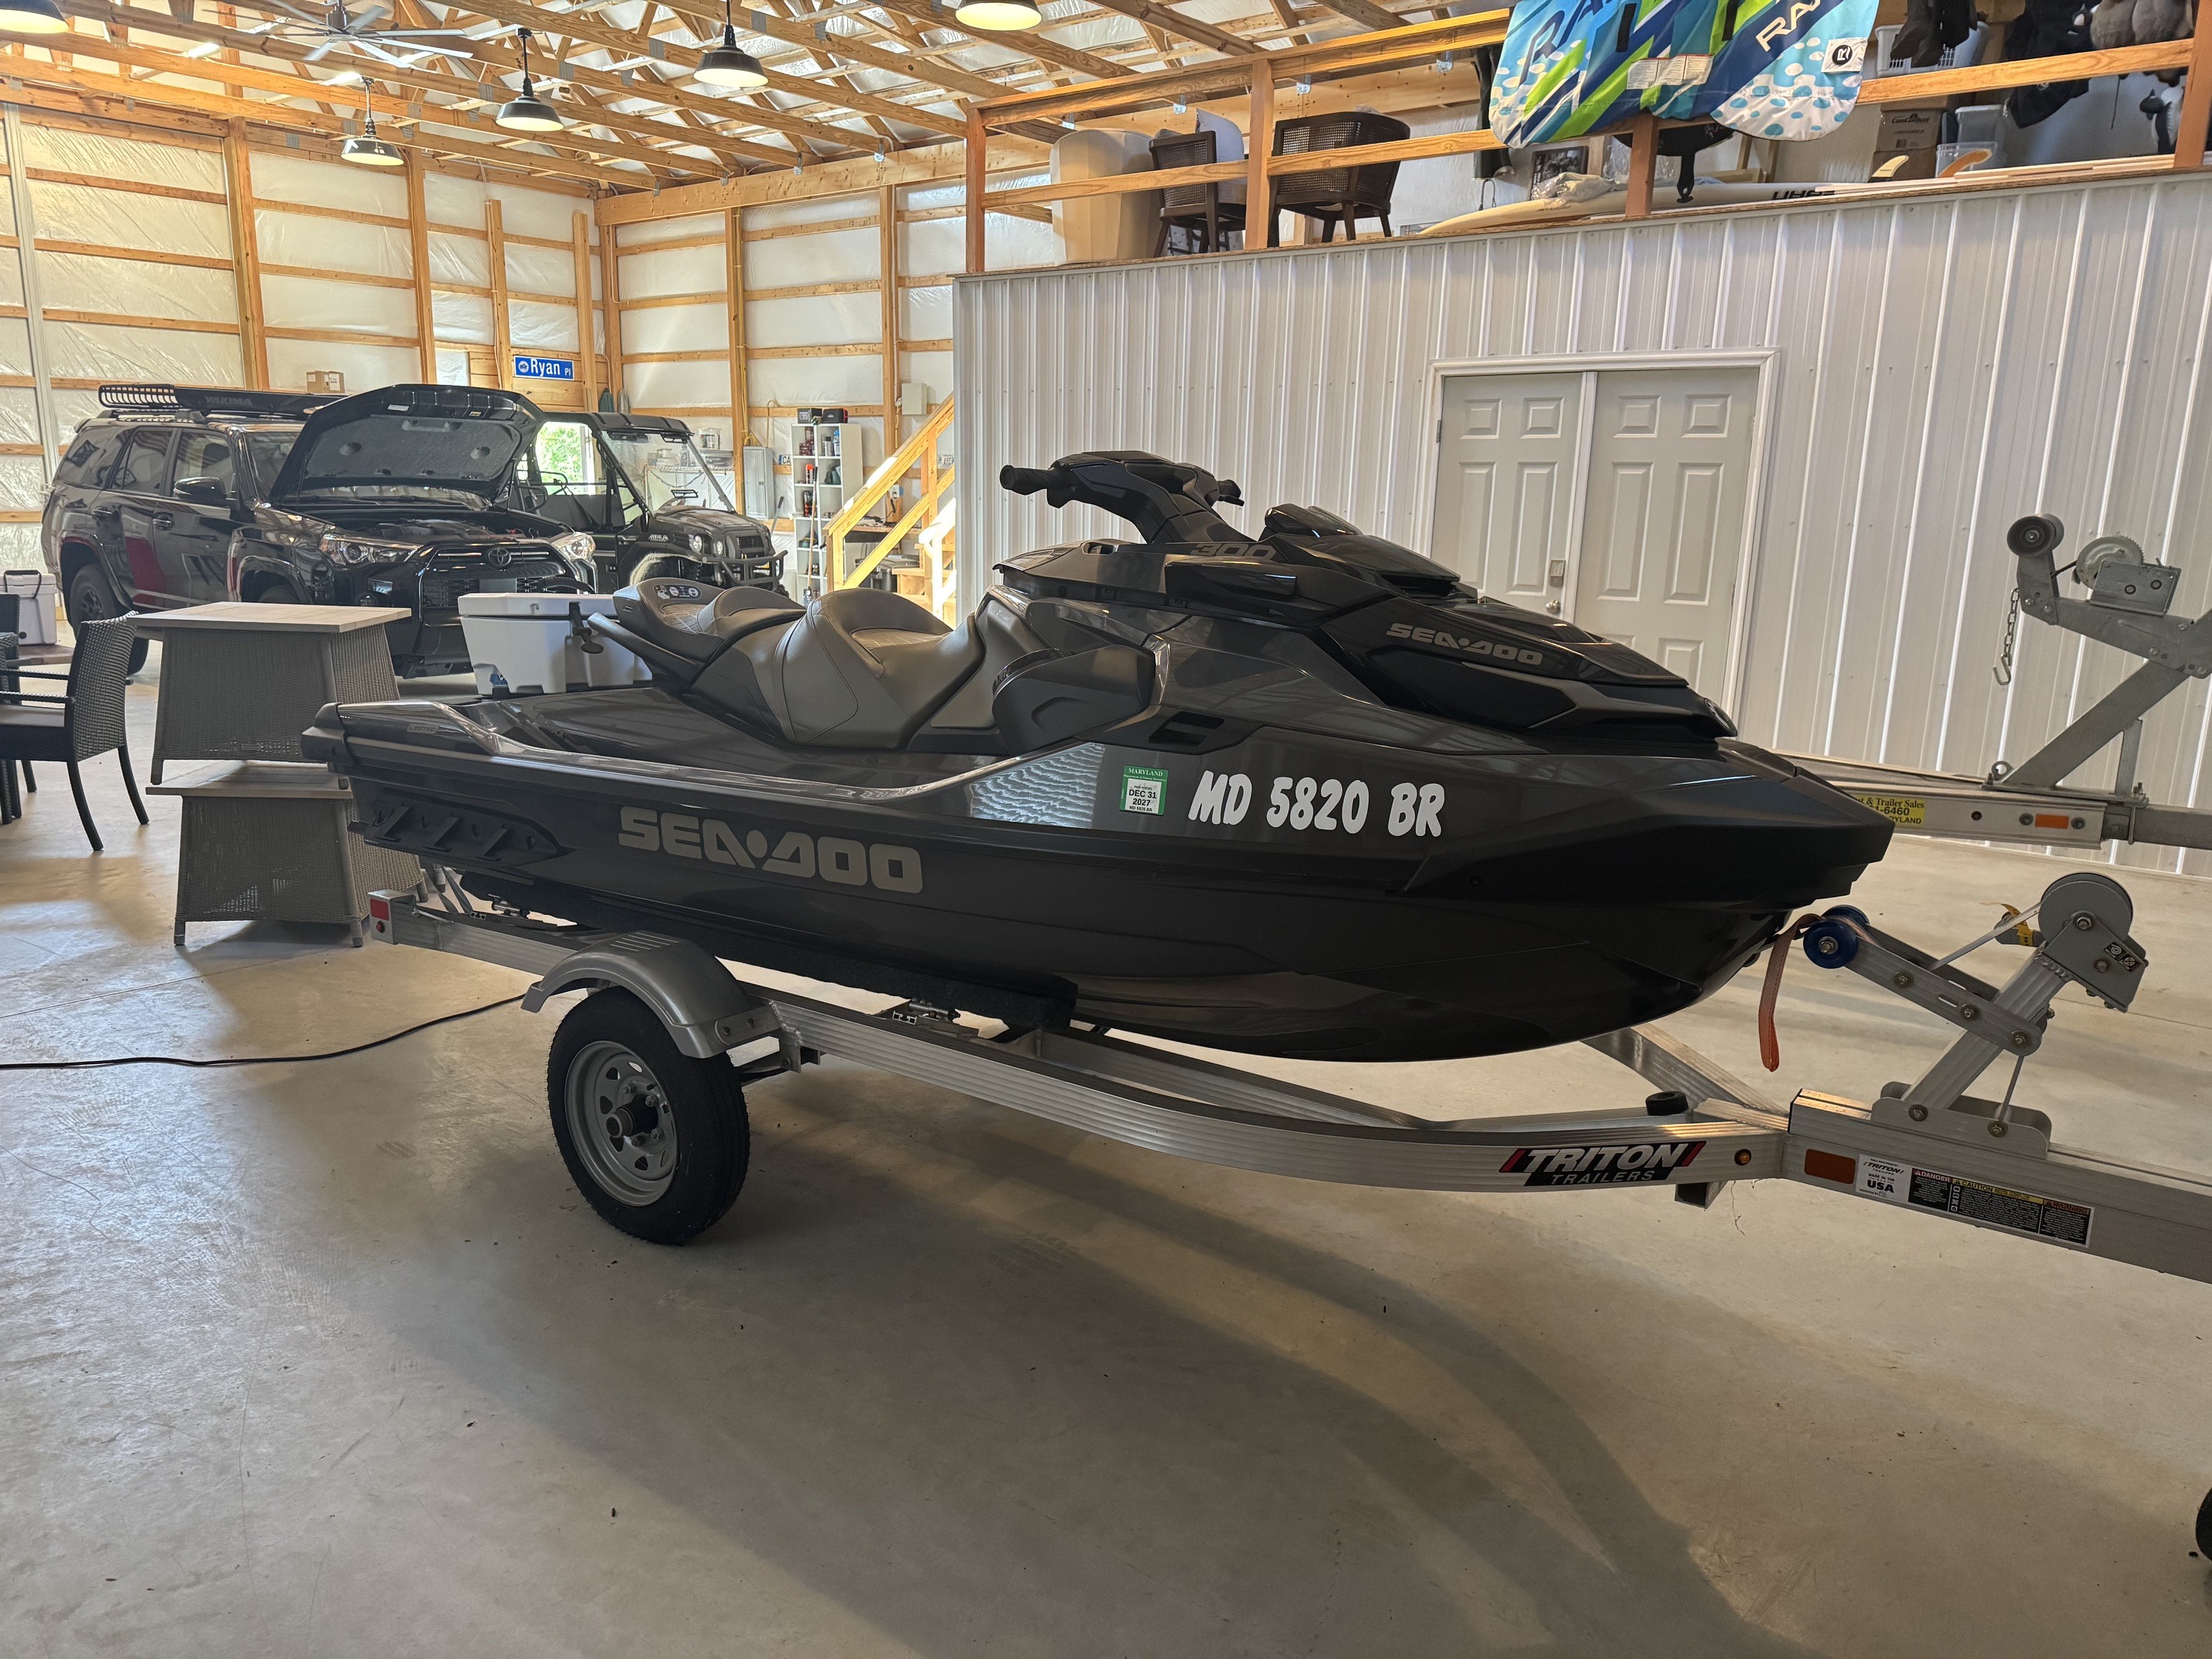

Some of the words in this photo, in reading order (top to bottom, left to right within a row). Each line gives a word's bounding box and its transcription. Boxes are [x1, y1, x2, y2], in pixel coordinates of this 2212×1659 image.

[531, 359, 560, 376] Ryan
[1190, 543, 1277, 559] 300
[1128, 768, 1163, 777] MARYLAND
[1128, 788, 1146, 798] DEC
[1147, 791, 1156, 799] 31
[1132, 798, 1151, 806] 2027
[1188, 770, 1252, 826] MD
[1266, 776, 1369, 834] 5820
[1387, 782, 1445, 837] BR
[1876, 797, 1903, 807] Trailer
[1904, 800, 1925, 809] Sales
[1523, 1143, 1689, 1173] TRITON
[1867, 1163, 1901, 1173] TRITON
[1551, 1170, 1655, 1185] TRAILERS
[1921, 1171, 1951, 1183] DANGER
[1867, 1179, 1894, 1194] USA
[1962, 1181, 1994, 1193] CAUTION
[2053, 1203, 2090, 1214] WARNING
